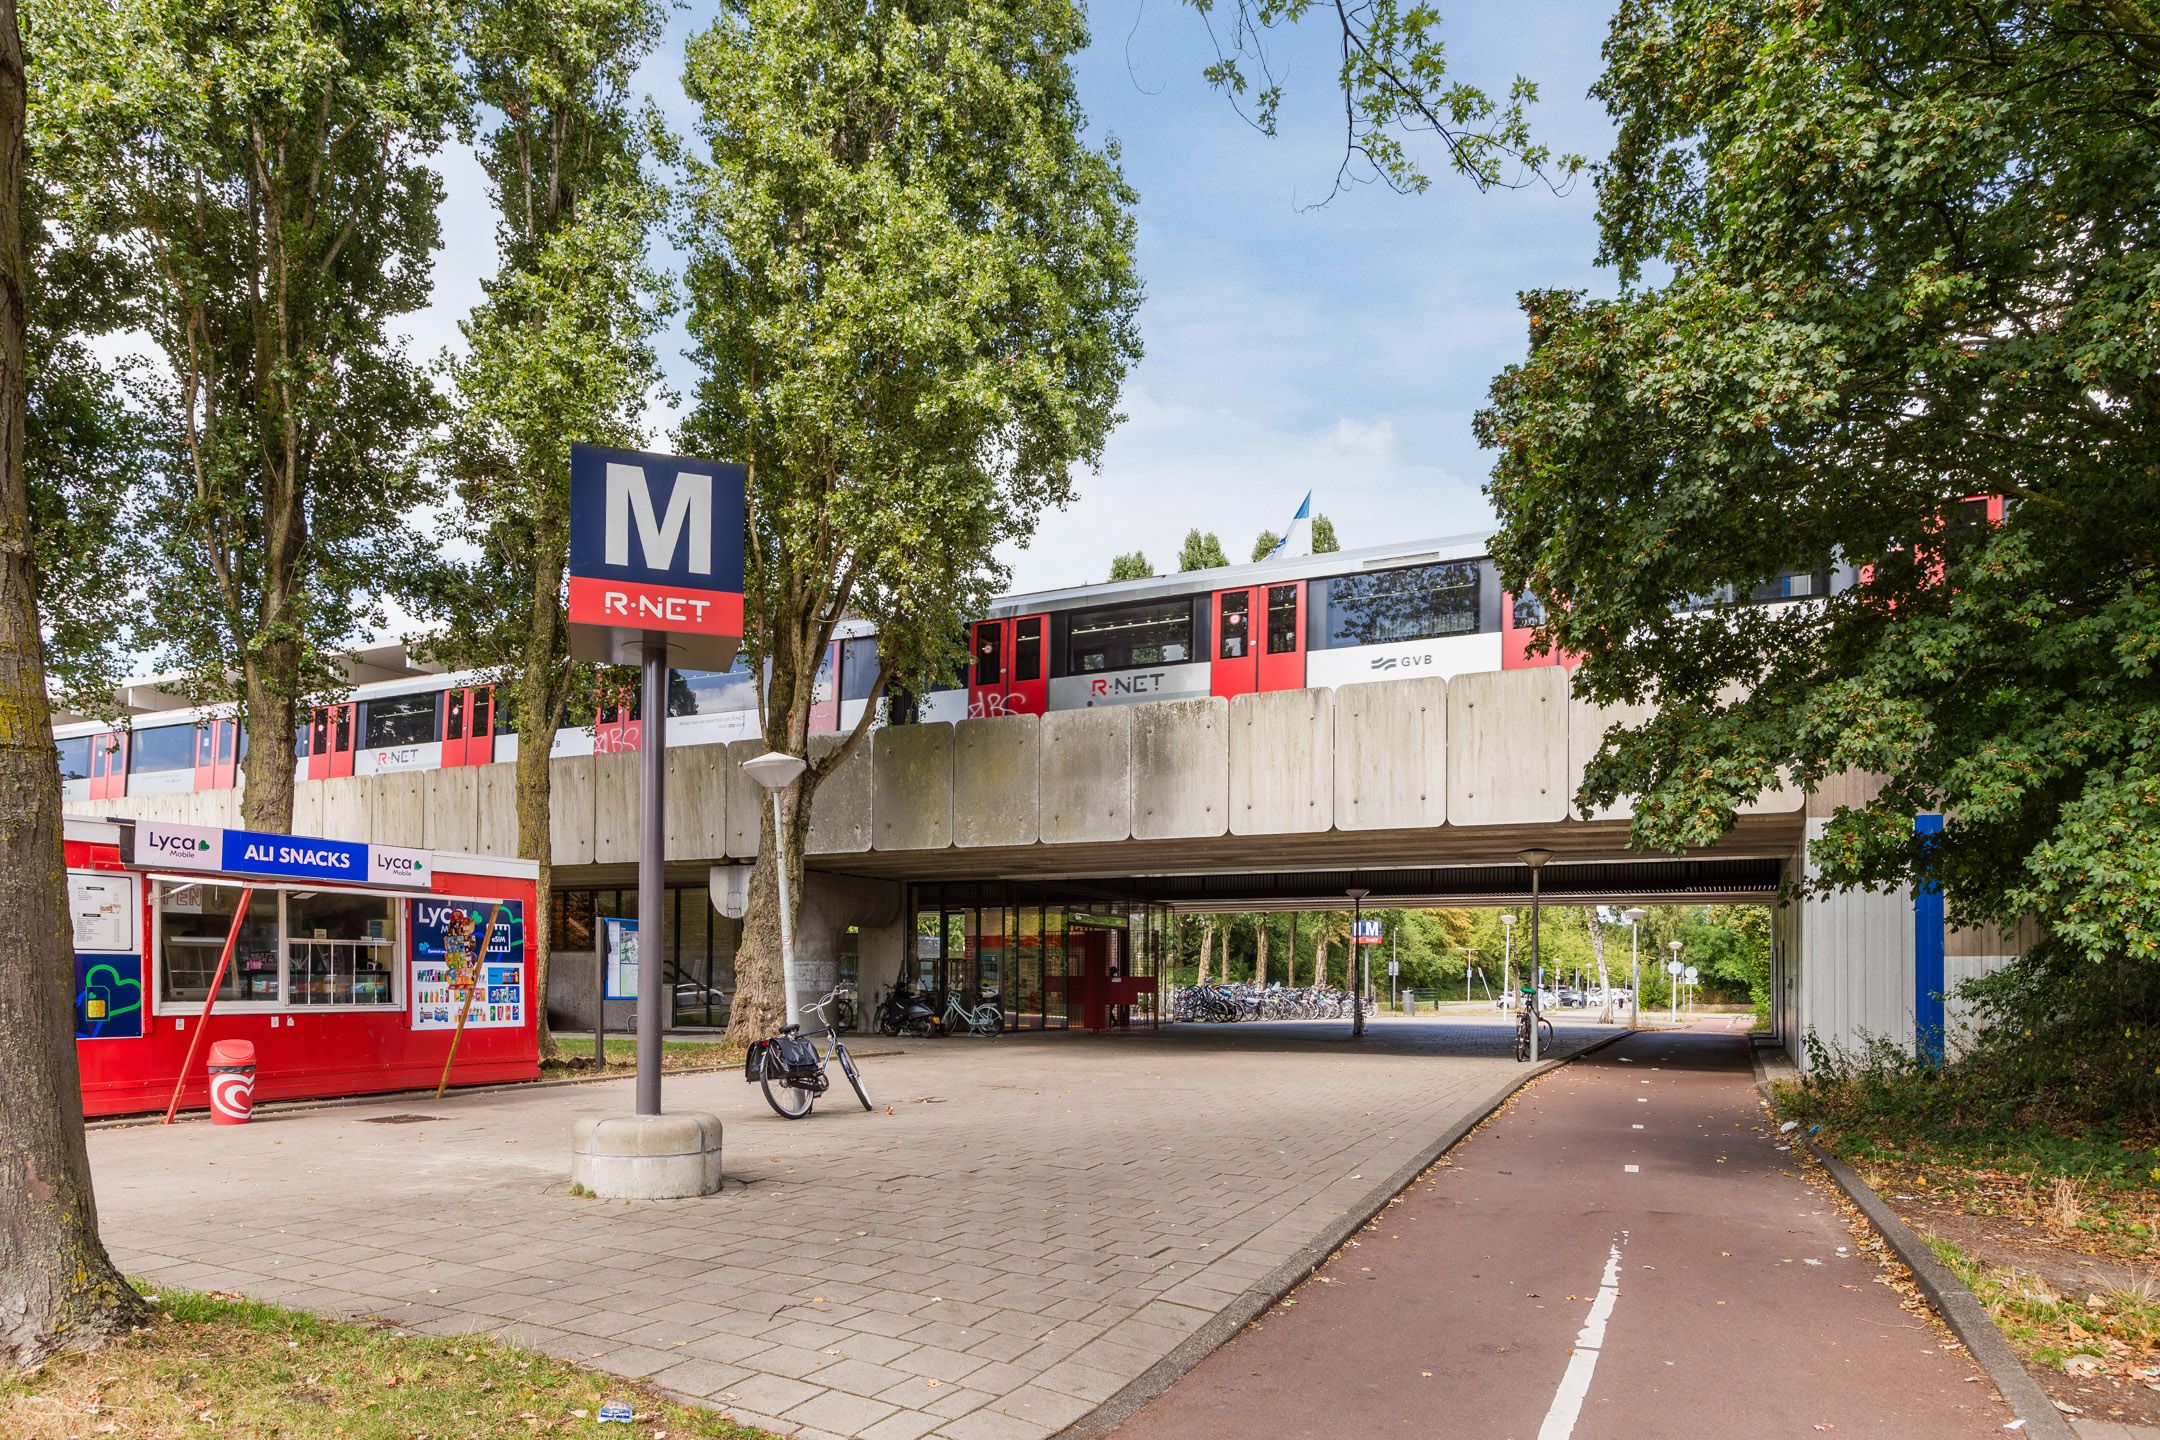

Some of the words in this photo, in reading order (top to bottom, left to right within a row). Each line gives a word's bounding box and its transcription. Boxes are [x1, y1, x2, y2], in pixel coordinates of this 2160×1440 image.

[605, 462, 712, 575] M
[1401, 654, 1432, 667] GVB
[149, 831, 196, 851] Lyca
[169, 849, 195, 859] Mobile
[243, 844, 274, 862] ALI
[278, 847, 351, 869] SNACKS
[377, 853, 412, 871] Lyca
[392, 869, 412, 877] Mobile
[162, 887, 201, 907] PEN
[1365, 921, 1378, 936] M
[491, 935, 506, 943] eSIM
